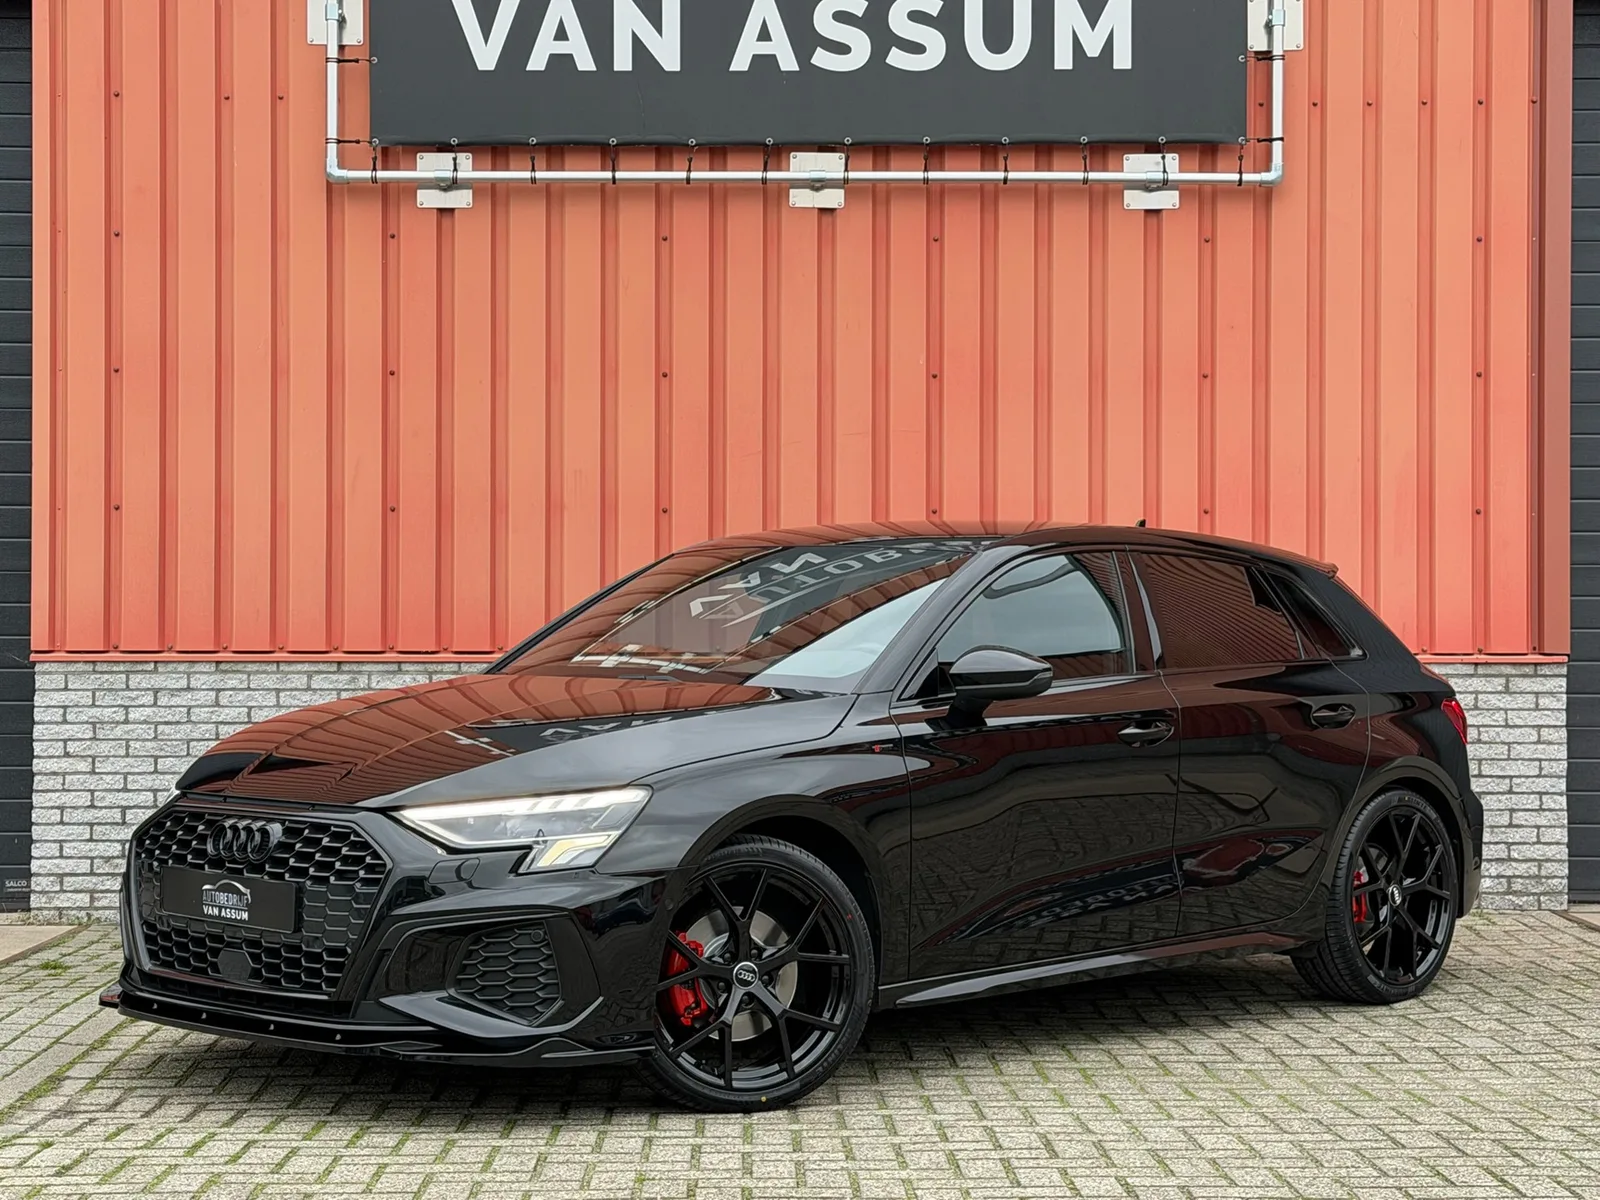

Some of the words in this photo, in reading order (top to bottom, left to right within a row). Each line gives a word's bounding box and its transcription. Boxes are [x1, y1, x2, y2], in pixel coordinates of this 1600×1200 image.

[452, 0, 681, 71] VAN
[729, 0, 1133, 72] ASSUM
[203, 890, 248, 906] AUTOBEDRIJF
[203, 905, 218, 916] VAN
[221, 908, 248, 920] ASSUM
